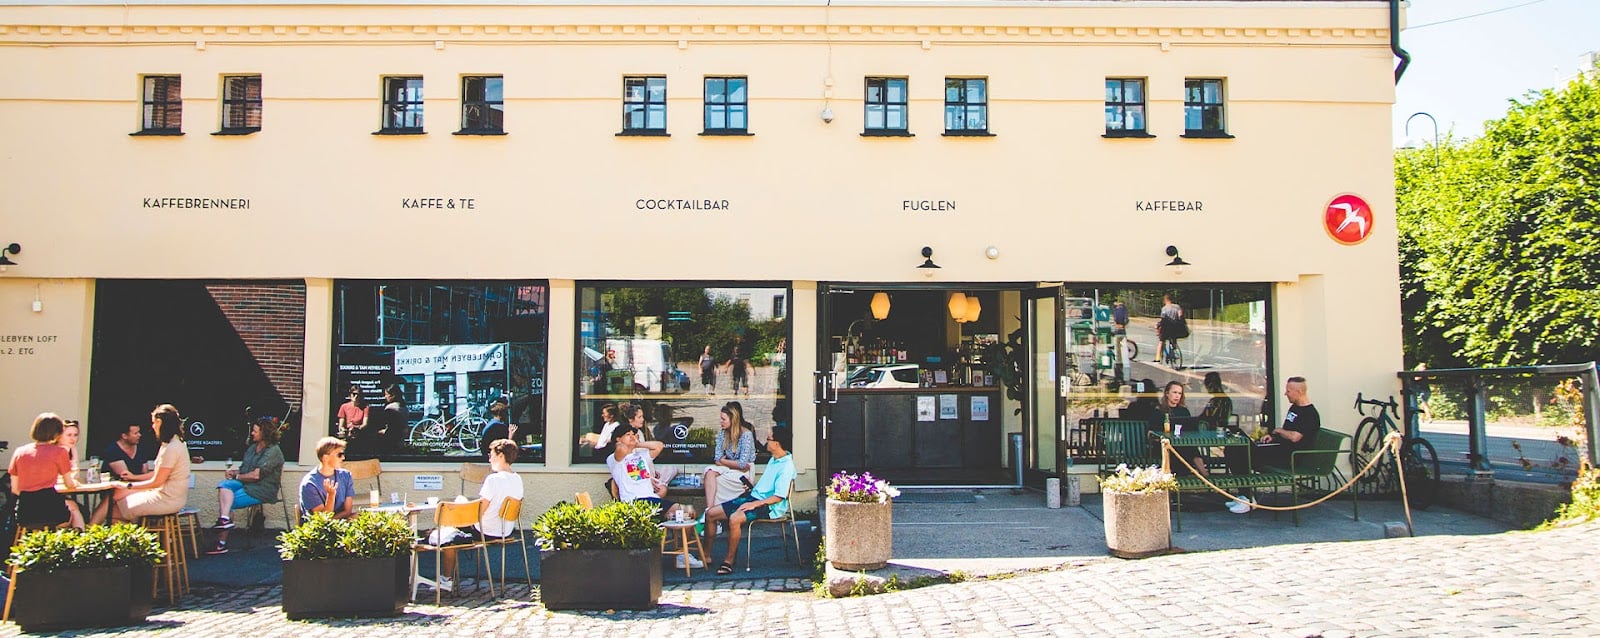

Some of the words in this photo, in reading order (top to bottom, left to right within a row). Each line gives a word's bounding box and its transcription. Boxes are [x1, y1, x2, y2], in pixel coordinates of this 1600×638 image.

[143, 197, 250, 210] KAFFEBRENNERI
[402, 198, 443, 210] KAFFE
[446, 198, 456, 210] &
[459, 198, 475, 210] TE
[635, 199, 729, 210] COCKTAILBAR
[903, 200, 956, 212] FUGLEN
[1136, 200, 1203, 212] KAFFEBAR
